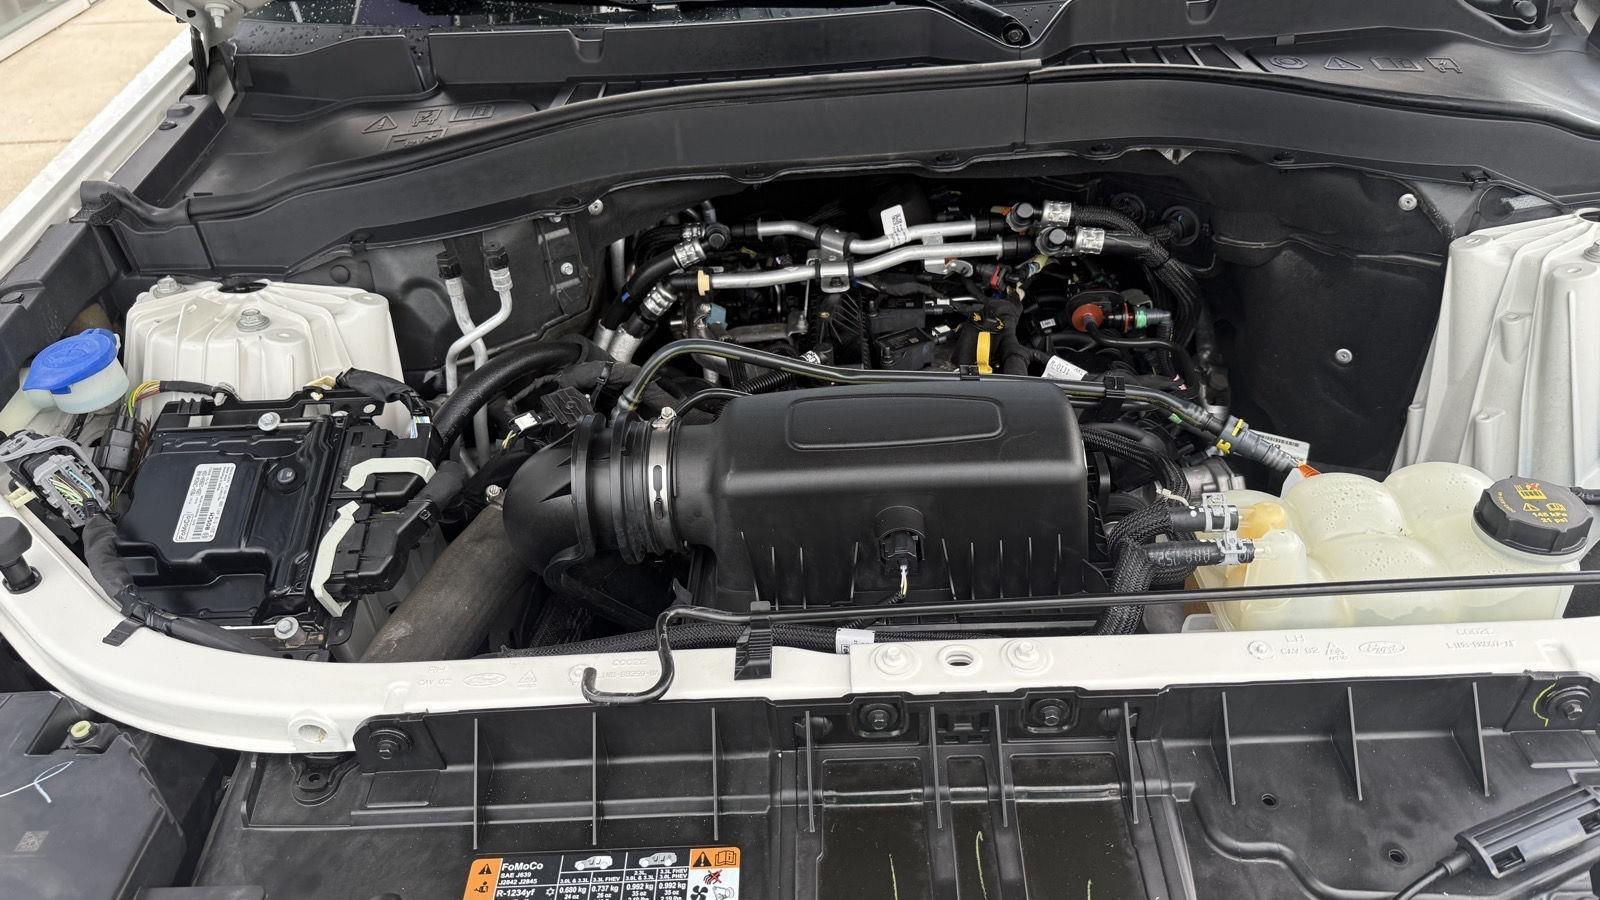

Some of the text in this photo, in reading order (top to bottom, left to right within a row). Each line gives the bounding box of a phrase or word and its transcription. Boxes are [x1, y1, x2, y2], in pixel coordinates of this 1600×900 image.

[204, 512, 214, 530] BOSCH
[178, 515, 191, 540] FoMoCo
[501, 861, 544, 871] FoMoCo
[577, 886, 587, 894] kg
[610, 884, 619, 893] kg
[644, 882, 654, 891] kg
[677, 881, 687, 890] kg
[496, 888, 536, 898] R-1234yf
